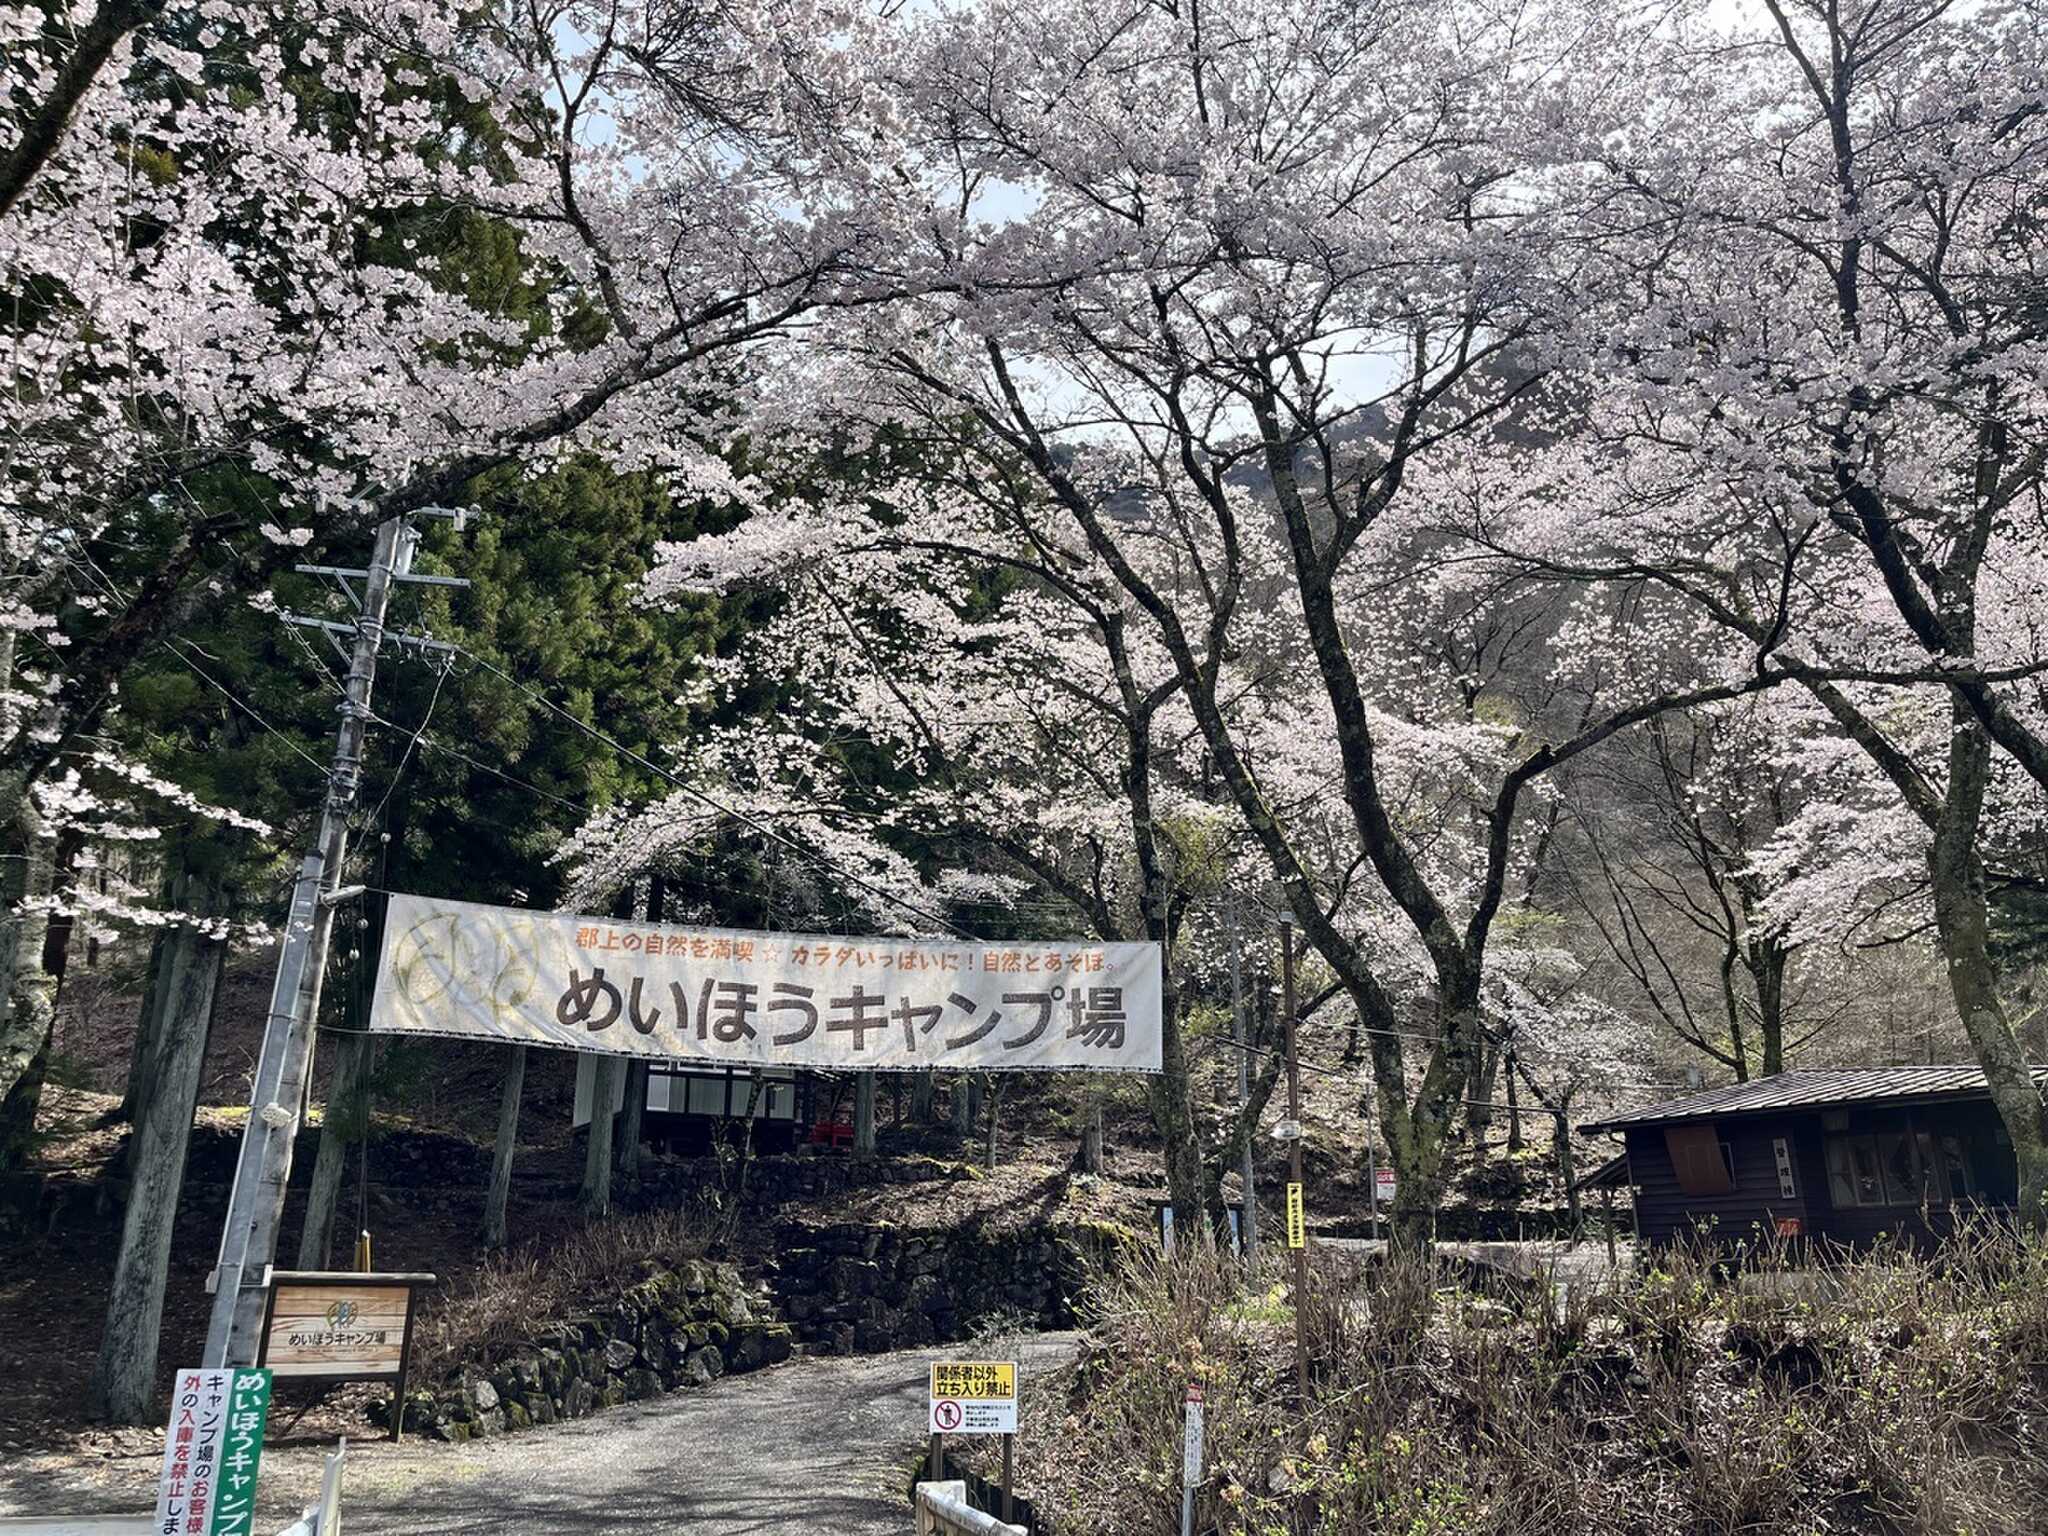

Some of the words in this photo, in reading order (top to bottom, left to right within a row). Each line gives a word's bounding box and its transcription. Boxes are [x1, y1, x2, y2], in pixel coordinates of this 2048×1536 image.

[576, 927, 754, 963] 郡上の自然を満喫
[556, 967, 1127, 1052] めいほうキャンプ場
[288, 1330, 386, 1346] めいほうキャンプ場
[936, 1366, 997, 1380] 関係者以外
[936, 1381, 1010, 1396] 立ち入り禁止
[216, 1372, 266, 1536] めいほうキャンプ
